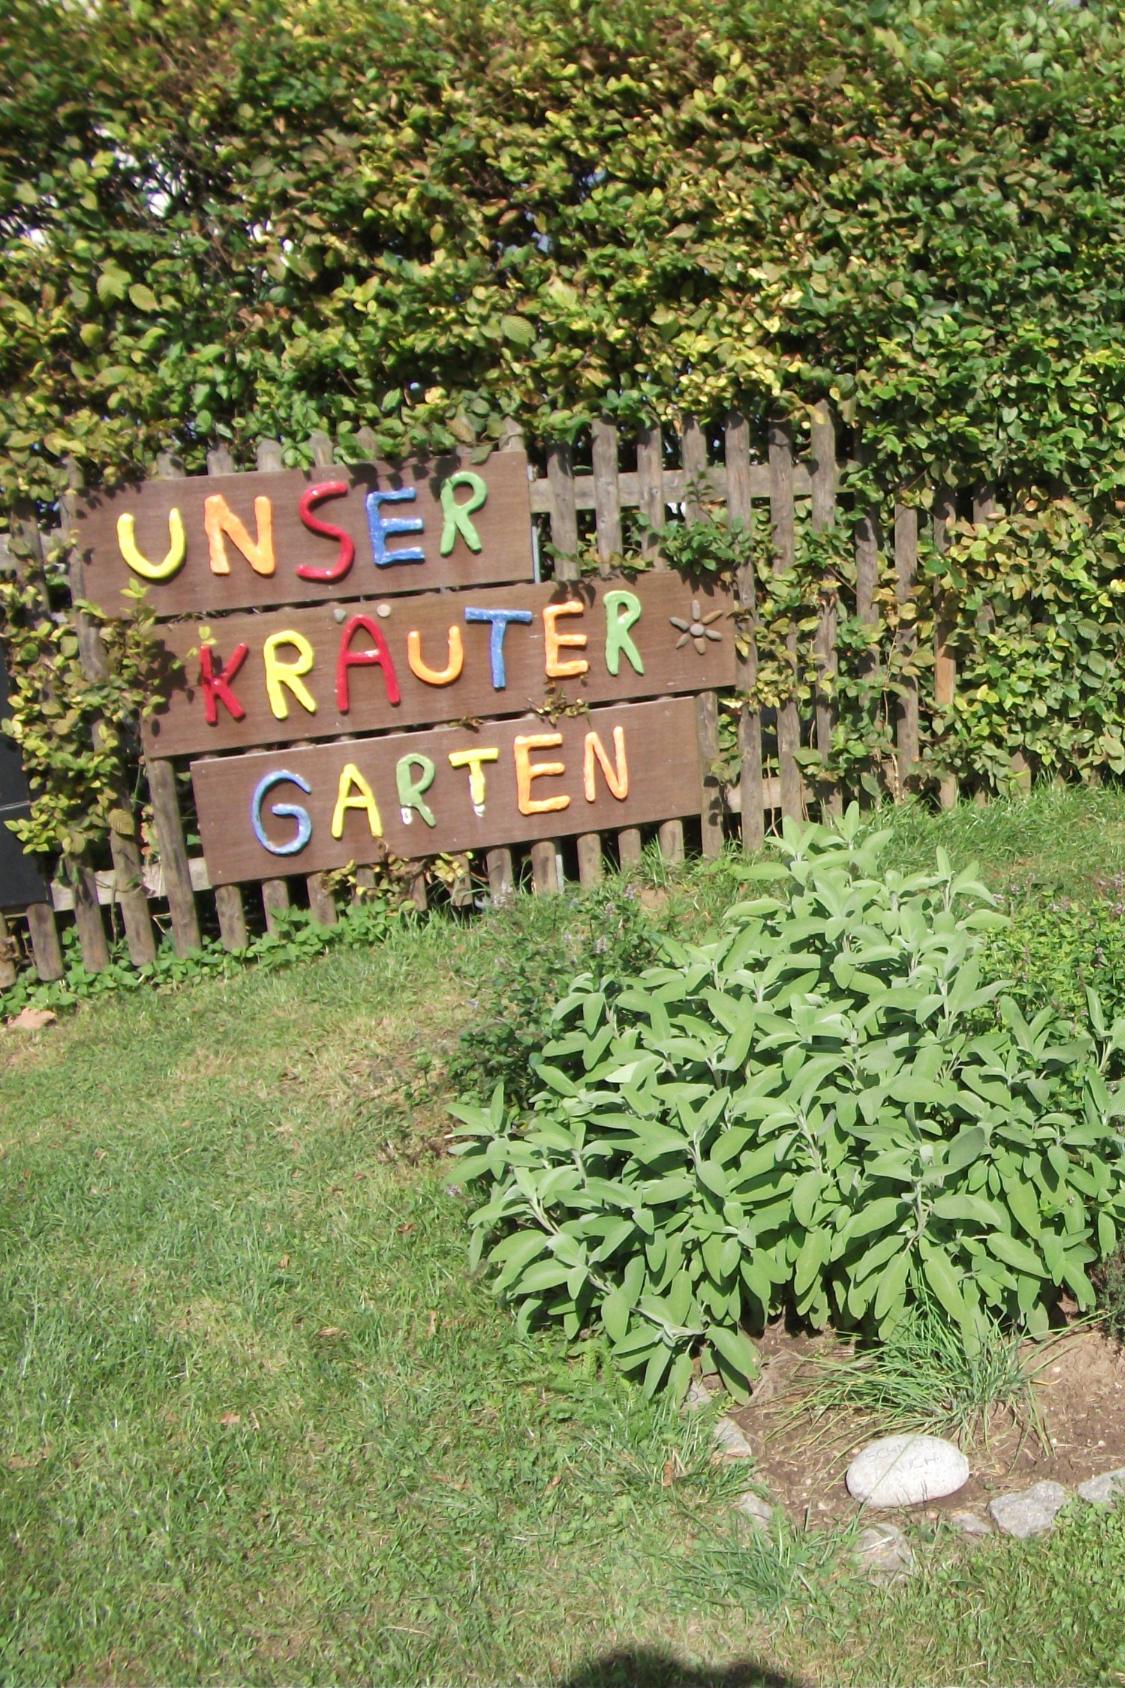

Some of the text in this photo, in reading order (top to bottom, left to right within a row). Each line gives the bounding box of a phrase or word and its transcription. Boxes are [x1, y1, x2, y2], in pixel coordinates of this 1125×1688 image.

[116, 471, 488, 582] UNSER
[199, 590, 645, 725] KRÄUTER
[252, 726, 629, 856] GARTEN
